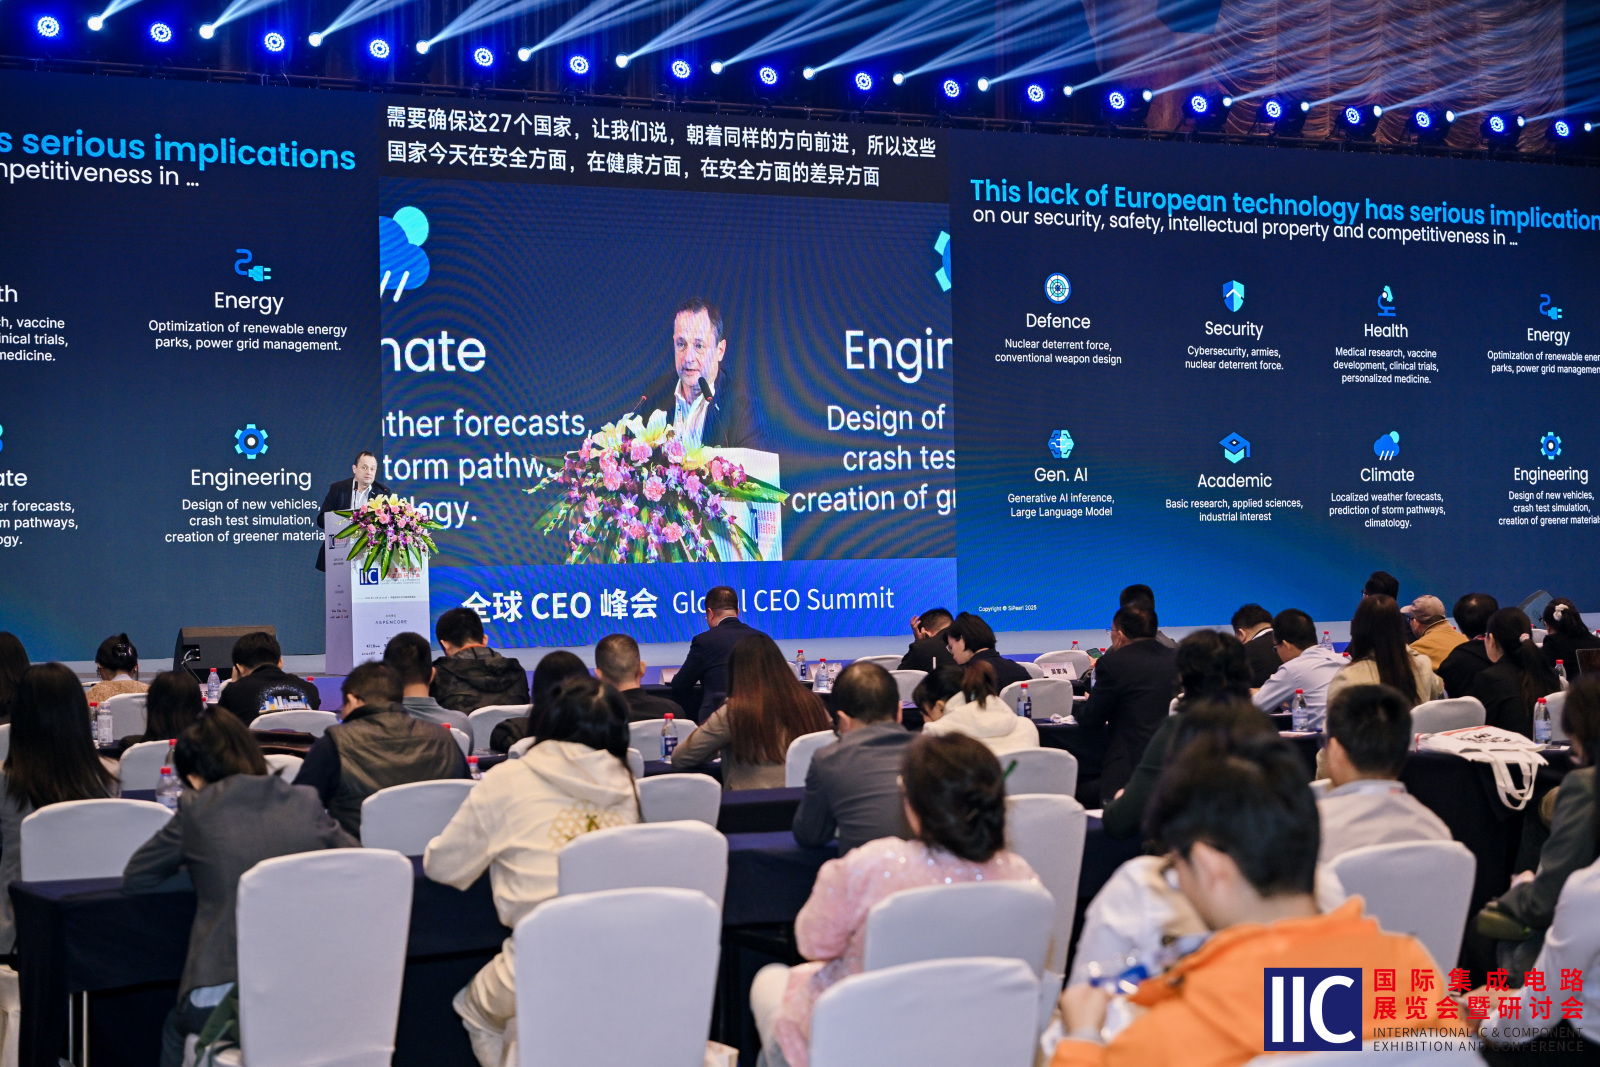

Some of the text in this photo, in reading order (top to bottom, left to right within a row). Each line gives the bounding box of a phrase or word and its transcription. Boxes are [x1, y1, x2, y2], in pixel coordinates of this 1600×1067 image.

[22, 128, 146, 157] serious
[154, 132, 356, 171] implications
[387, 140, 880, 187] 国家今天在安全方面，在健康方面，在安全方面的差异方面
[159, 165, 179, 186] in
[970, 178, 1600, 234] This lack of European technology has serious implication
[973, 208, 996, 222] on
[1001, 210, 1030, 224] our
[1033, 209, 1105, 233] security,
[1109, 211, 1164, 235] safety,
[1168, 213, 1258, 234] intellectual
[1262, 221, 1330, 242] property
[1333, 222, 1364, 239] and
[1367, 225, 1490, 246] competitiveness
[1492, 228, 1506, 245] in
[214, 291, 285, 316] Energy
[17, 316, 65, 328] vaccine
[1026, 312, 1091, 329] Defence
[149, 319, 348, 337] Optimization of renewable energy
[1204, 320, 1264, 341] Security
[1365, 323, 1409, 337] Health
[34, 333, 69, 347] trials,
[156, 336, 342, 352] parks, power grid management.
[1527, 327, 1571, 347] Energy
[1005, 338, 1112, 351] Nuclear deterrent force,
[1188, 345, 1281, 358] Cybersecurity, armies,
[995, 352, 1122, 366] conventional weapon design
[1336, 346, 1437, 359] Medical research, vaccine
[1488, 349, 1534, 361] Optimization
[1536, 351, 1544, 360] of
[1545, 351, 1583, 361] renewable
[1185, 359, 1285, 370] nuclear deterrent force.
[1334, 359, 1439, 372] development, clinical trials,
[1492, 363, 1515, 373] parks,
[1516, 365, 1540, 374] power
[1541, 363, 1556, 375] grid
[1342, 373, 1432, 384] personalized medicine.
[382, 407, 593, 440] ther forecasts,
[827, 403, 946, 437] Design of
[842, 445, 912, 472] crash
[191, 467, 312, 492] Engineering
[1035, 467, 1088, 481] Gen. AI
[1198, 472, 1273, 487] Academic
[1361, 466, 1415, 481] Climate
[1513, 466, 1589, 486] Engineering
[791, 485, 896, 513] creation
[903, 483, 929, 510] of
[1008, 492, 1115, 503] Generative AI inference,
[1332, 491, 1444, 502] Localized weather forecasts,
[1509, 490, 1535, 501] Design
[1536, 490, 1544, 499] of
[1563, 490, 1595, 500] vehicles,
[12, 499, 75, 513] forecasts,
[183, 498, 321, 512] Design of new vehicles,
[1166, 497, 1304, 509] Basic research, applied sciences,
[1330, 504, 1446, 516] prediction of storm pathways,
[1513, 502, 1591, 512] crash test simulation,
[1011, 506, 1113, 519] Large Language Model
[1200, 511, 1272, 521] industrial interest
[15, 516, 79, 530] pathways,
[190, 513, 315, 527] crash test simulation,
[1365, 517, 1413, 529] climatology.
[1499, 515, 1529, 525] creation
[1531, 515, 1539, 524] of
[1540, 516, 1569, 526] greener
[165, 529, 325, 544] creation of greener materia
[460, 590, 523, 624] 全球
[530, 591, 592, 620] CEO
[600, 587, 659, 620] 峰会
[753, 588, 801, 612] CEO
[806, 586, 895, 611] Summit
[978, 605, 1002, 613] Copyright
